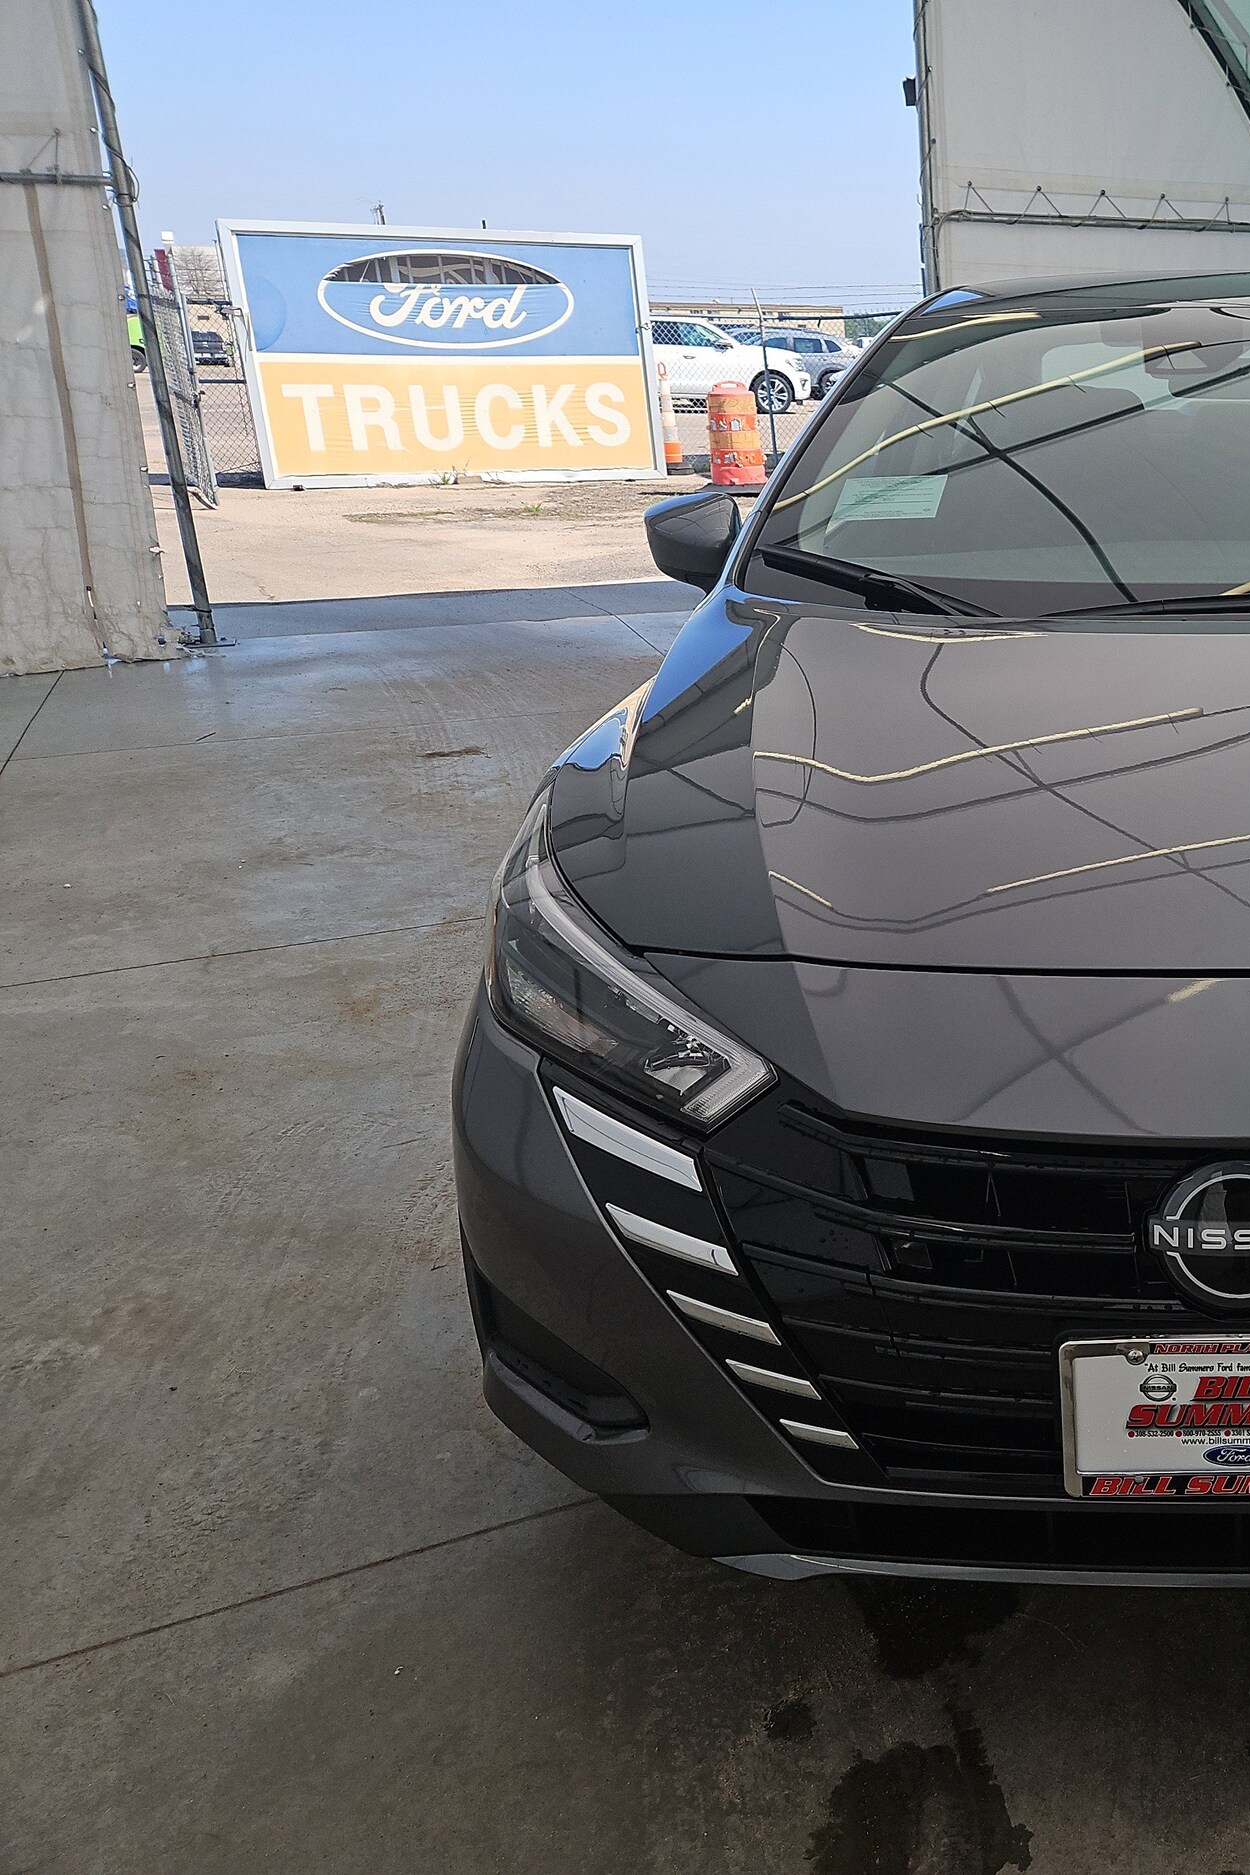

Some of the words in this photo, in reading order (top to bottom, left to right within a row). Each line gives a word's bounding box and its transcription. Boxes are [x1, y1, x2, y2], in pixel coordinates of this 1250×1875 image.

[369, 283, 528, 330] Ford
[281, 381, 632, 453] TRUCKS
[1154, 1343, 1219, 1354] NORTH
[1161, 1363, 1176, 1372] Bill
[1179, 1362, 1214, 1372] Summers
[1217, 1362, 1233, 1372] Ford
[1089, 1476, 1177, 1496] BILL
